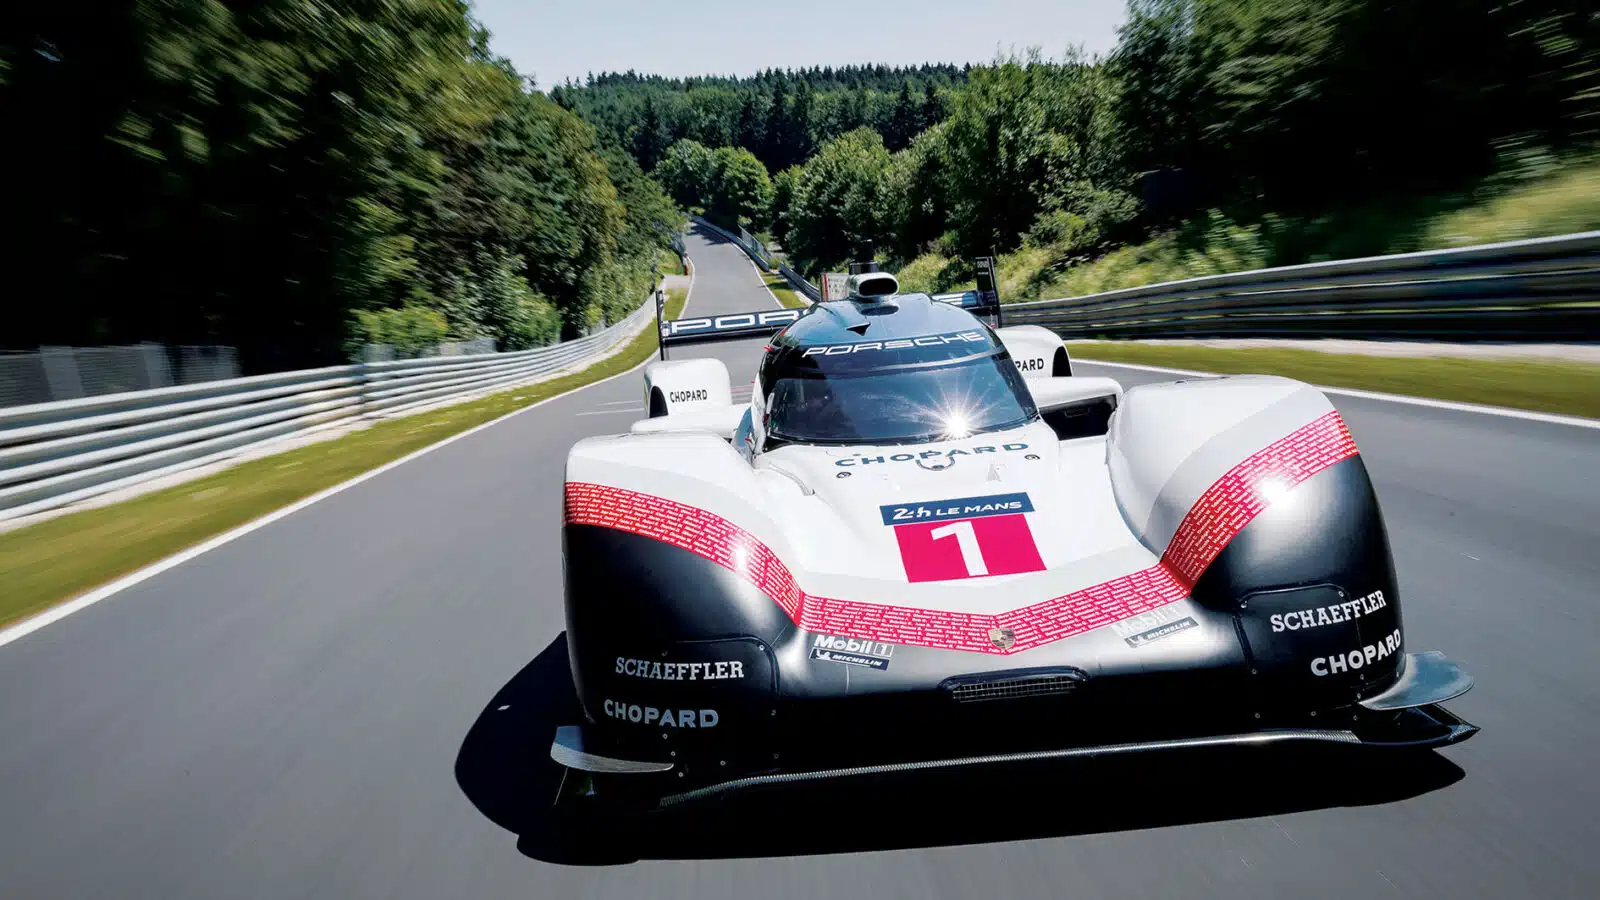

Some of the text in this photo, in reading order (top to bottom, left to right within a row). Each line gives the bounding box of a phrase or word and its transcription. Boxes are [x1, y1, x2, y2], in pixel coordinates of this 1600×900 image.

[671, 309, 807, 334] POR
[802, 331, 986, 358] PORSCHE
[669, 389, 708, 404] CHOPARD
[835, 443, 1029, 467] CHOPARD
[936, 507, 960, 516] LE
[964, 501, 1023, 514] MANS
[930, 520, 989, 577] 1
[1270, 590, 1387, 633] SCHAEFFLER
[1147, 620, 1191, 640] MICHELIN
[814, 634, 874, 654] Mobil
[1310, 628, 1401, 677] CHOPARD
[615, 656, 745, 681] SCHAEFFLER
[832, 654, 883, 666] MICHELIN
[604, 699, 719, 728] CHOPARD
